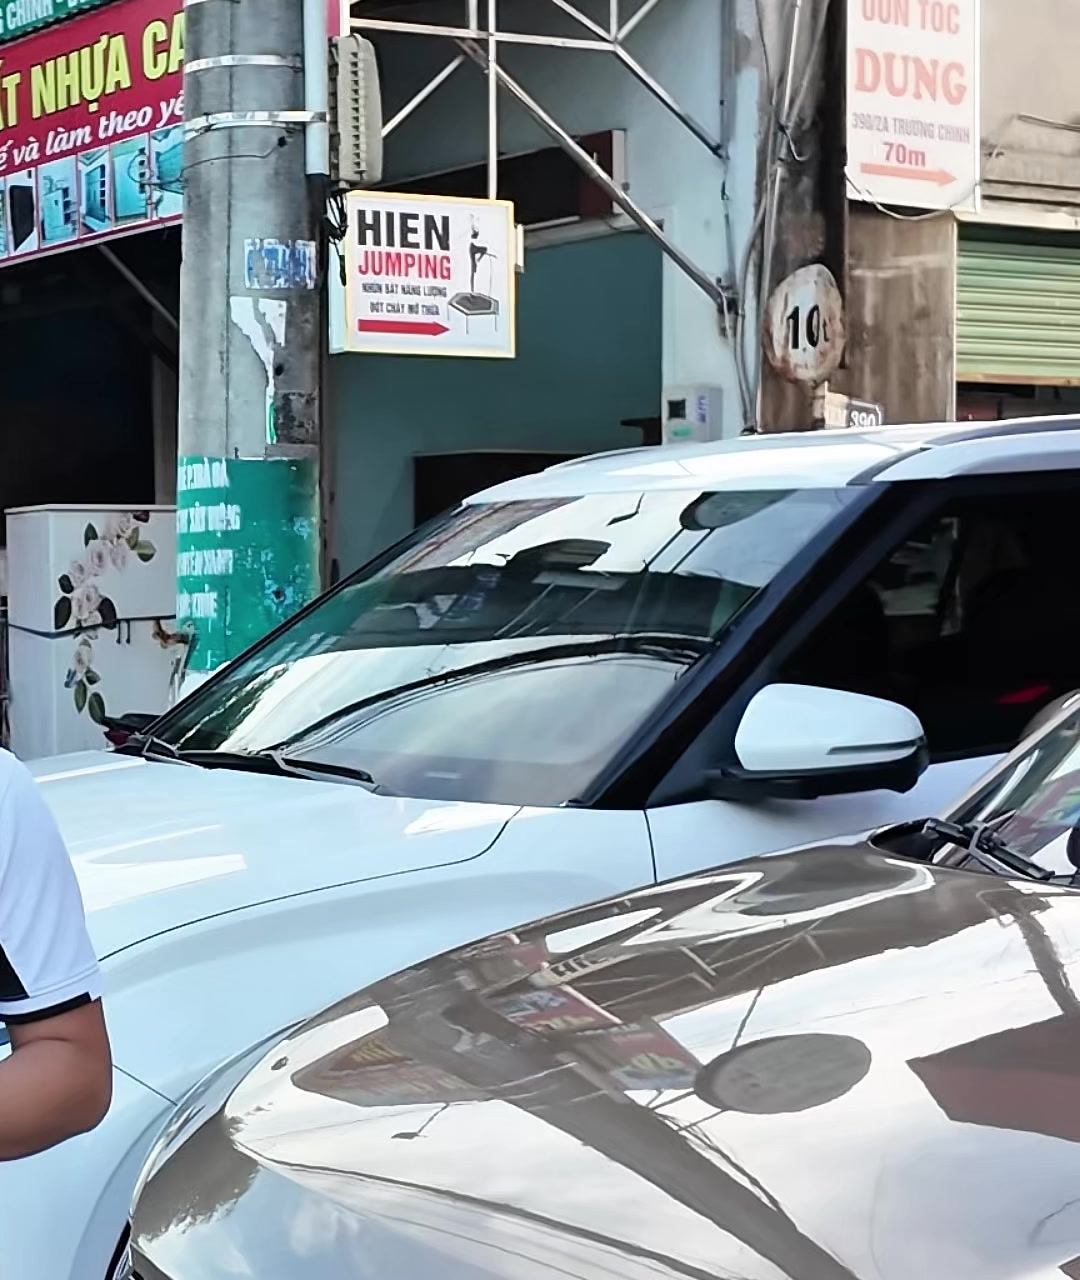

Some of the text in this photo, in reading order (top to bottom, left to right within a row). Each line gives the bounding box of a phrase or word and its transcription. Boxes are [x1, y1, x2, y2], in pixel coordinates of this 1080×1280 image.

[30, 32, 131, 118] NHỰA
[13, 144, 39, 168] và
[45, 125, 93, 159] làm
[99, 111, 152, 139] theo
[883, 142, 926, 167] 70m
[357, 209, 450, 251] HIEN
[358, 250, 451, 280] JUMPING
